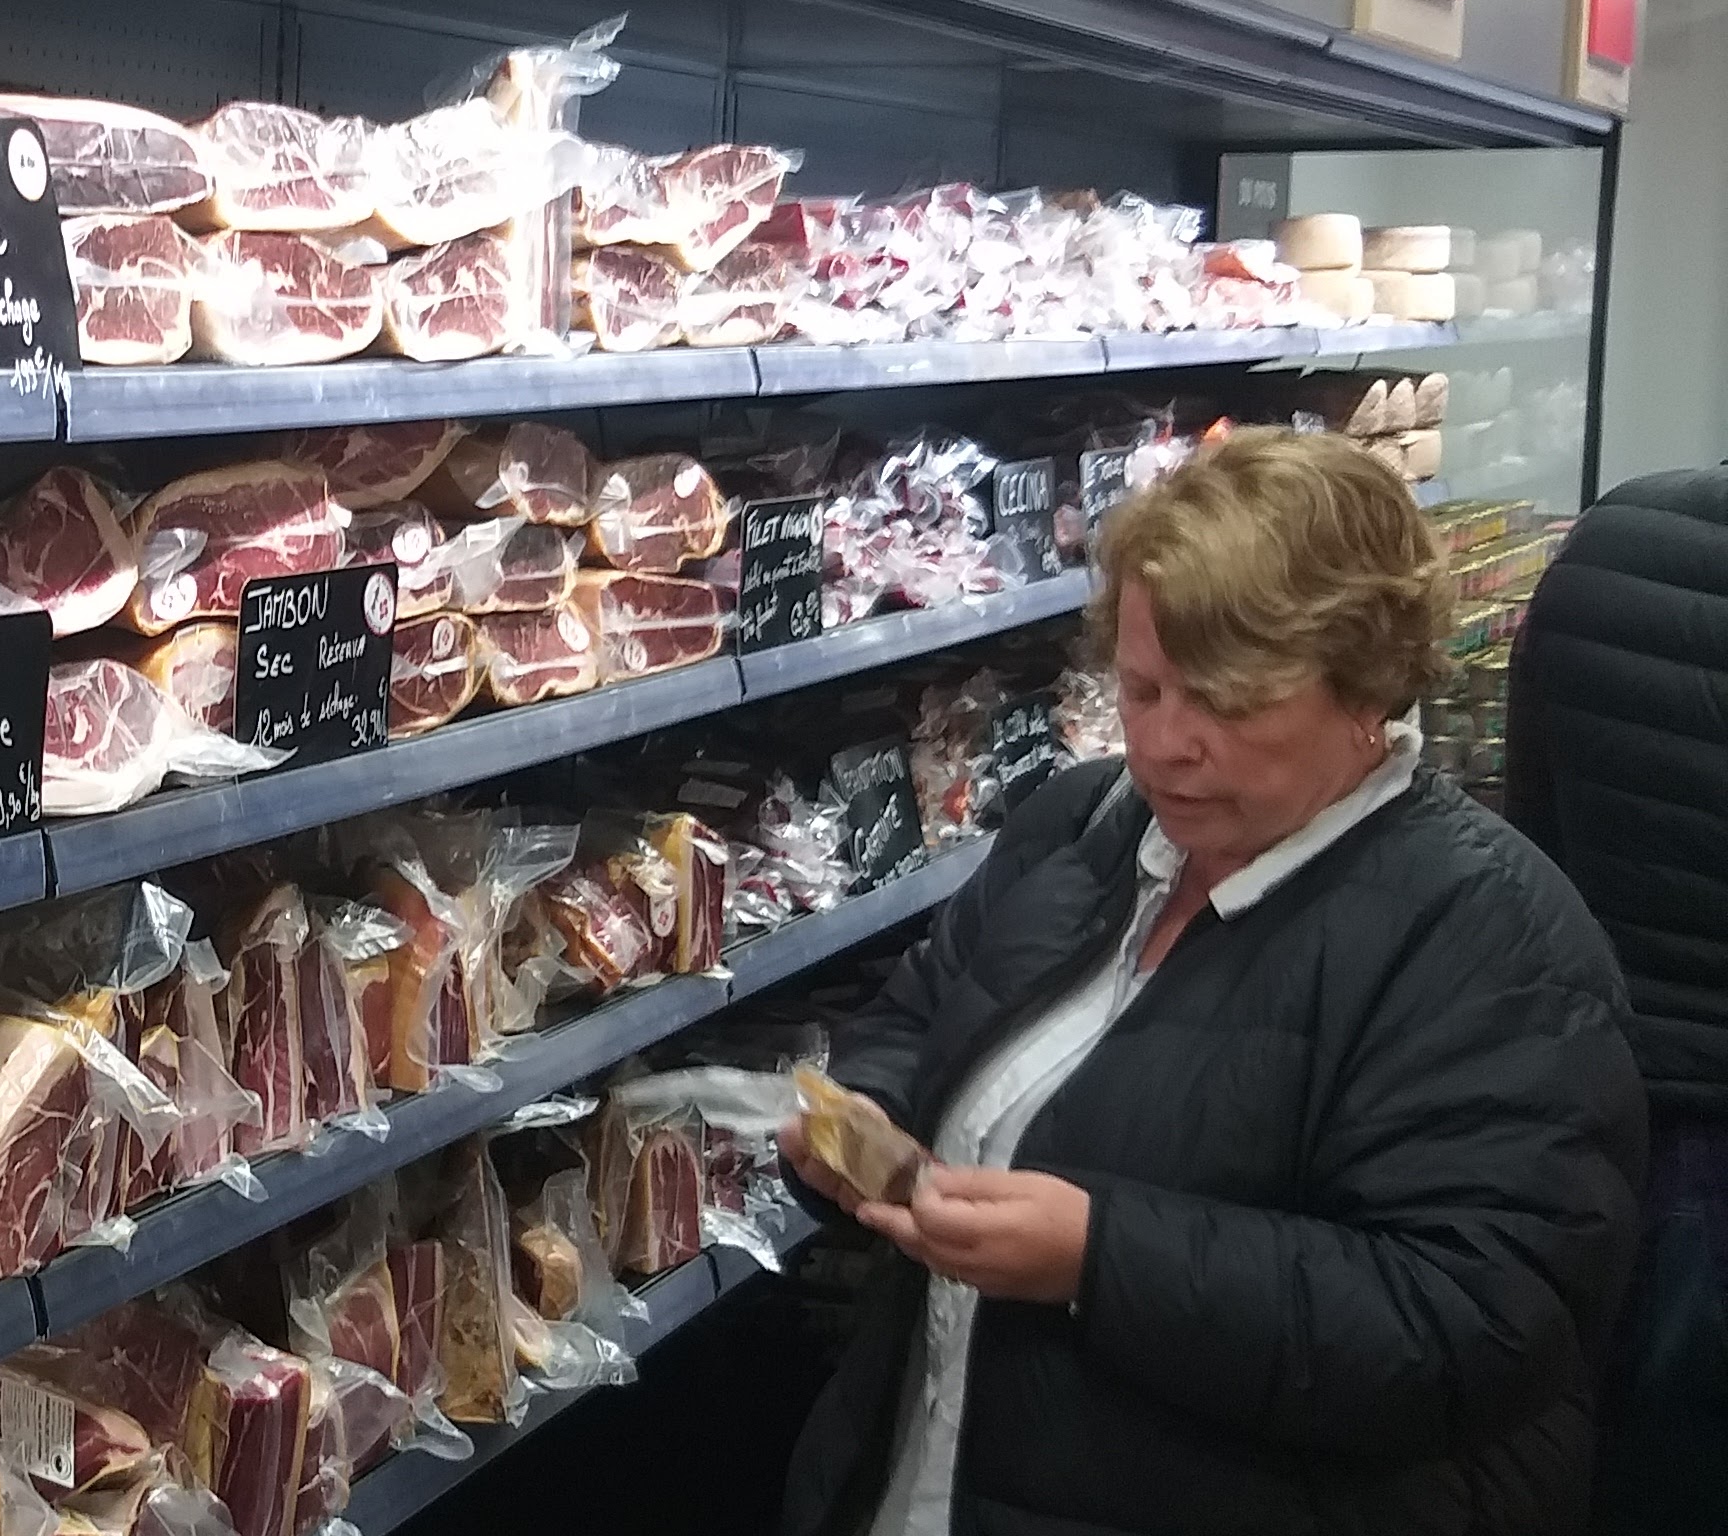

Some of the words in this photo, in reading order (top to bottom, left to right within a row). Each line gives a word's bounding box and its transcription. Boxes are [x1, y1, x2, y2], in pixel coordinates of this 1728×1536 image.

[745, 508, 781, 552] FILET
[245, 576, 329, 634] JAMBON
[250, 708, 273, 749] 12
[274, 711, 294, 740] mois
[300, 692, 311, 728] de
